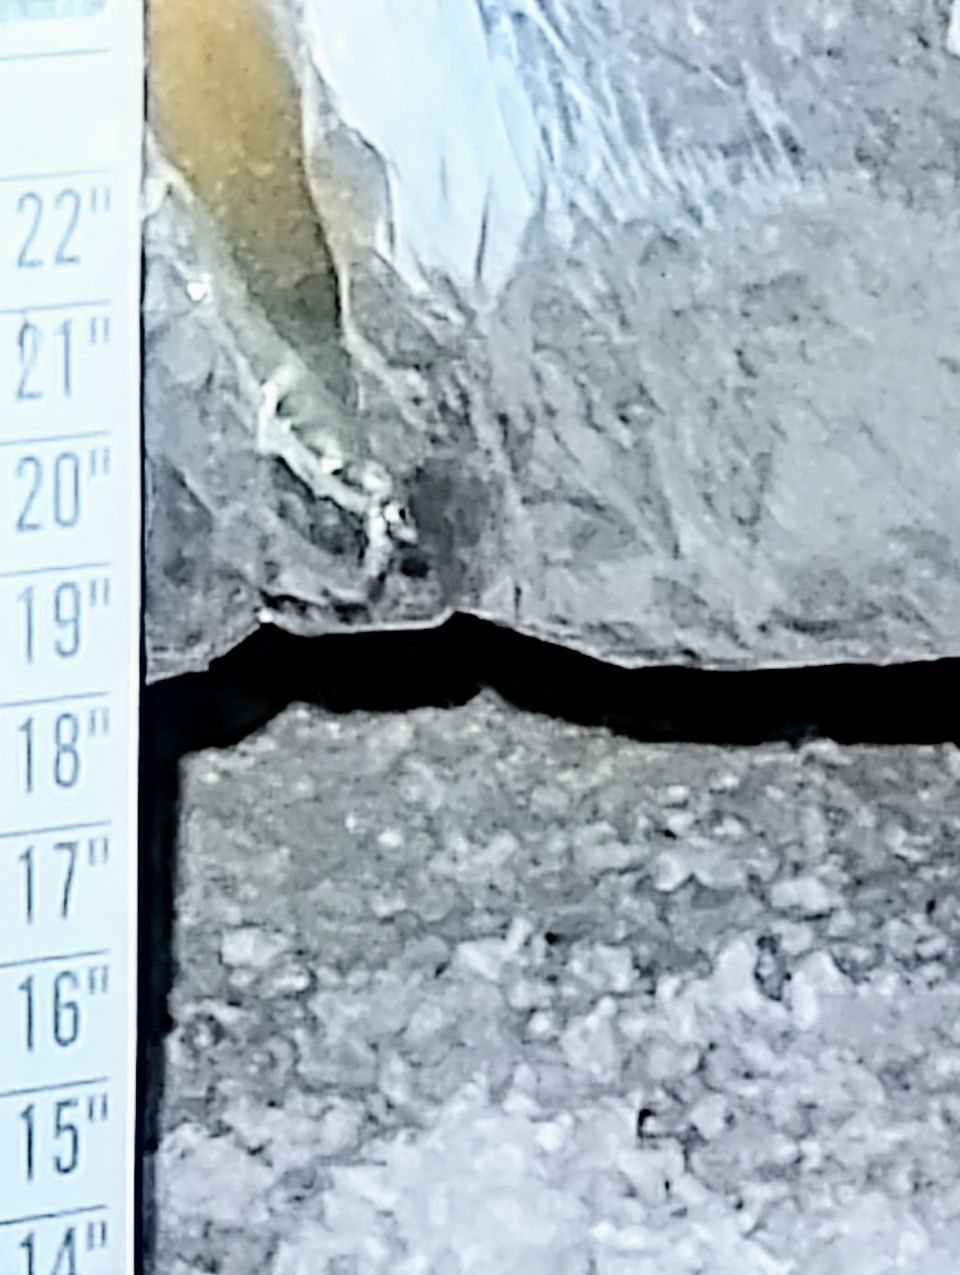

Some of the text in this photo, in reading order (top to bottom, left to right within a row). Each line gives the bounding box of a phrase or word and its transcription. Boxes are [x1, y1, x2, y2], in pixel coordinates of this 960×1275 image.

[16, 186, 111, 269] 22"
[16, 315, 111, 400] 21"
[16, 447, 111, 533] 20"
[17, 577, 111, 664] 19"
[18, 707, 110, 794] 18"
[18, 837, 109, 924] 17"
[18, 966, 109, 1052] 16"
[19, 1093, 108, 1181] 15"
